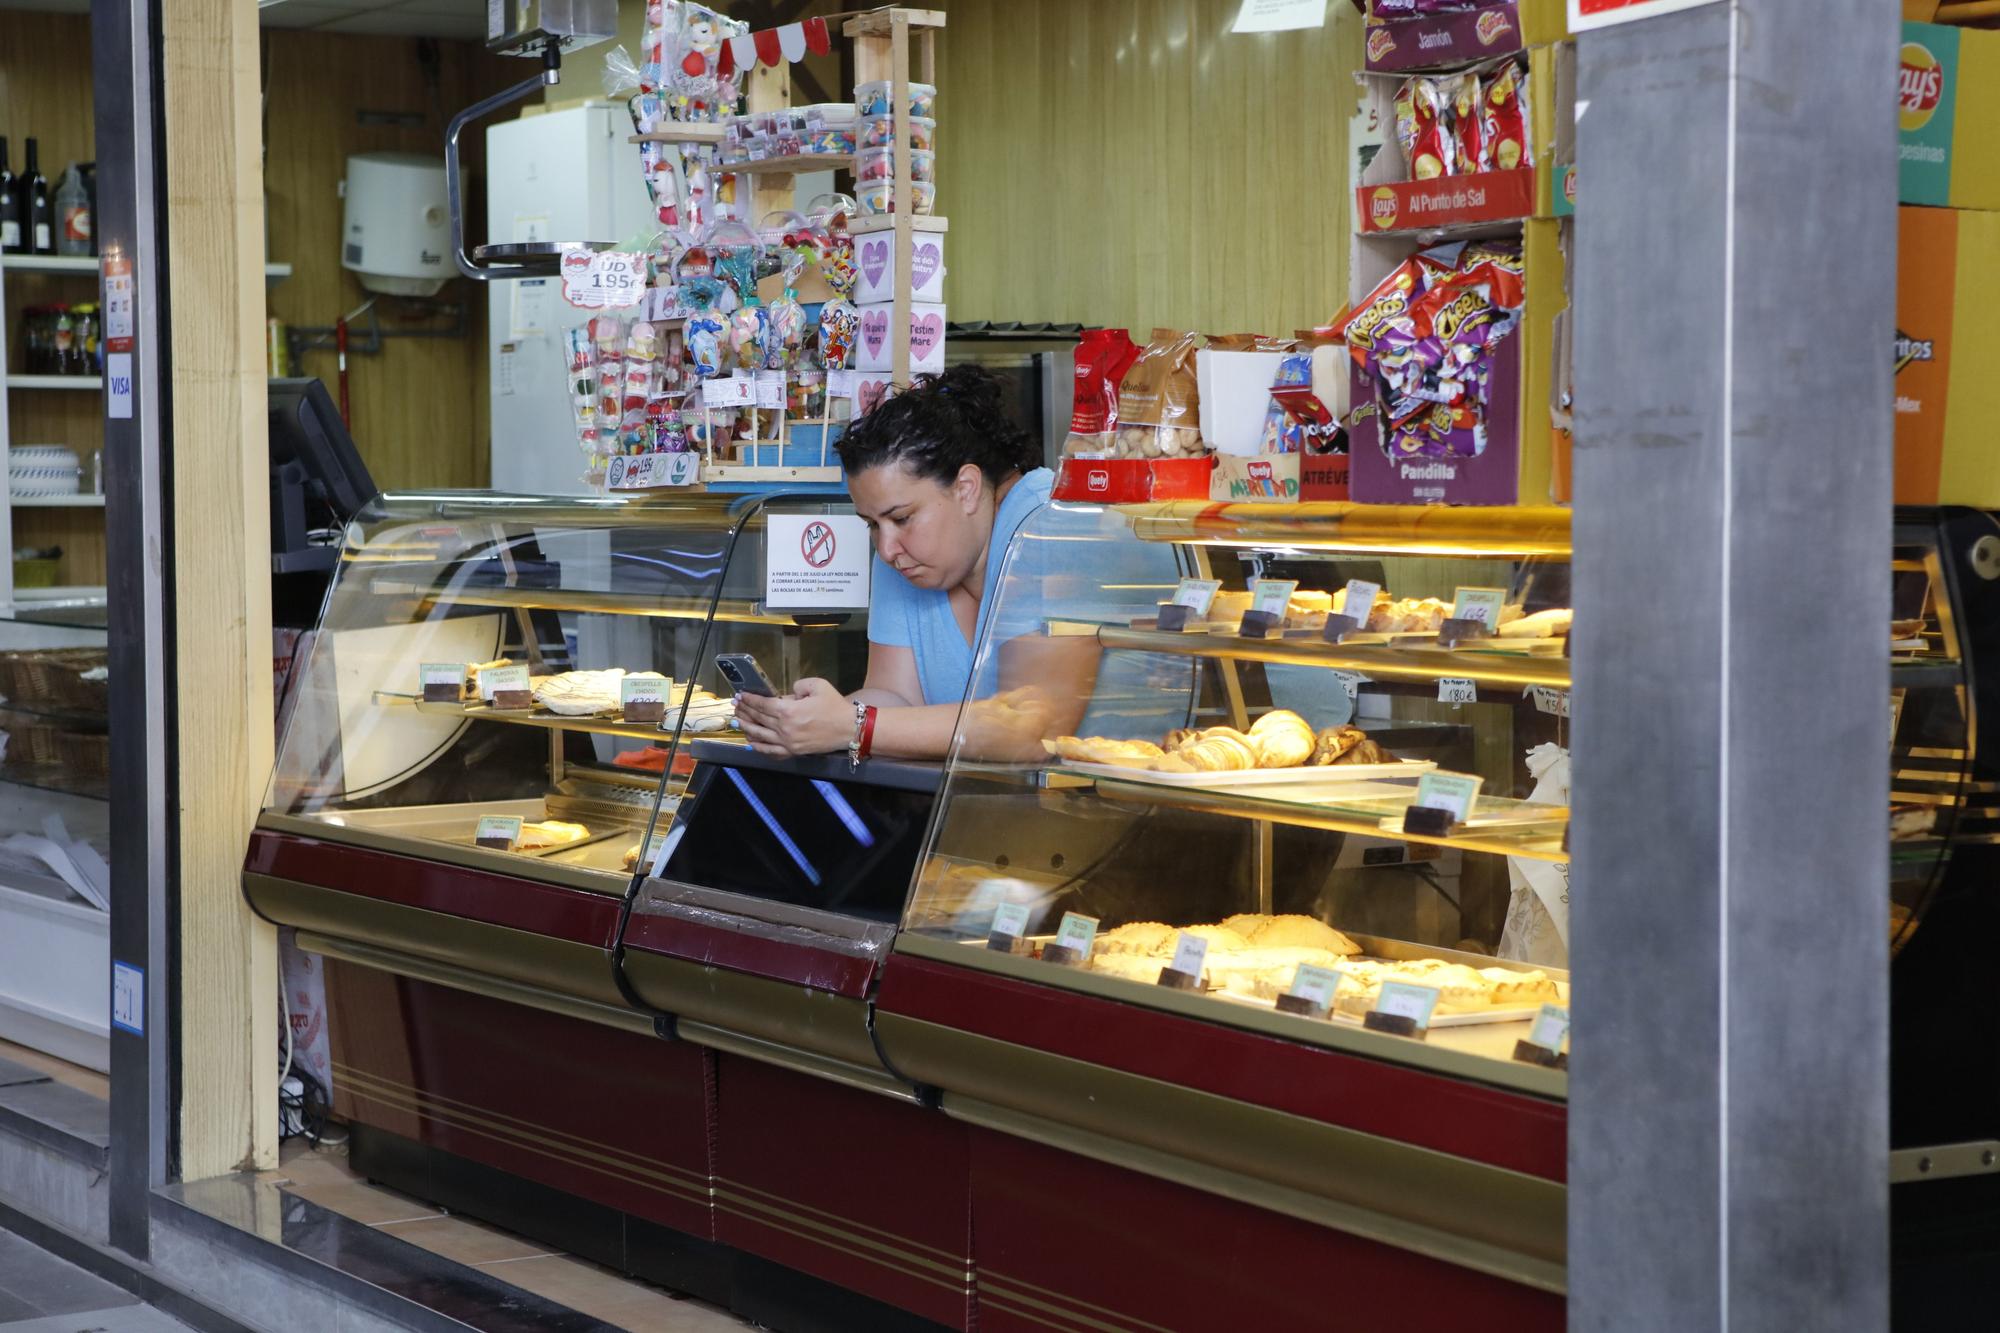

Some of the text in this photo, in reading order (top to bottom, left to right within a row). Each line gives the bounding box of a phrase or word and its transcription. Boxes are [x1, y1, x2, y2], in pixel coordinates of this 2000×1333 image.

[1418, 28, 1452, 49] Jamón
[1899, 66, 1940, 112] ay's
[1373, 196, 1397, 218] Lay's
[1409, 187, 1486, 213] Al Punto de Sal
[1346, 291, 1406, 349] Cheetos
[910, 336, 931, 346] Mare
[111, 377, 130, 395] VISA
[1401, 463, 1455, 480] Pandilla
